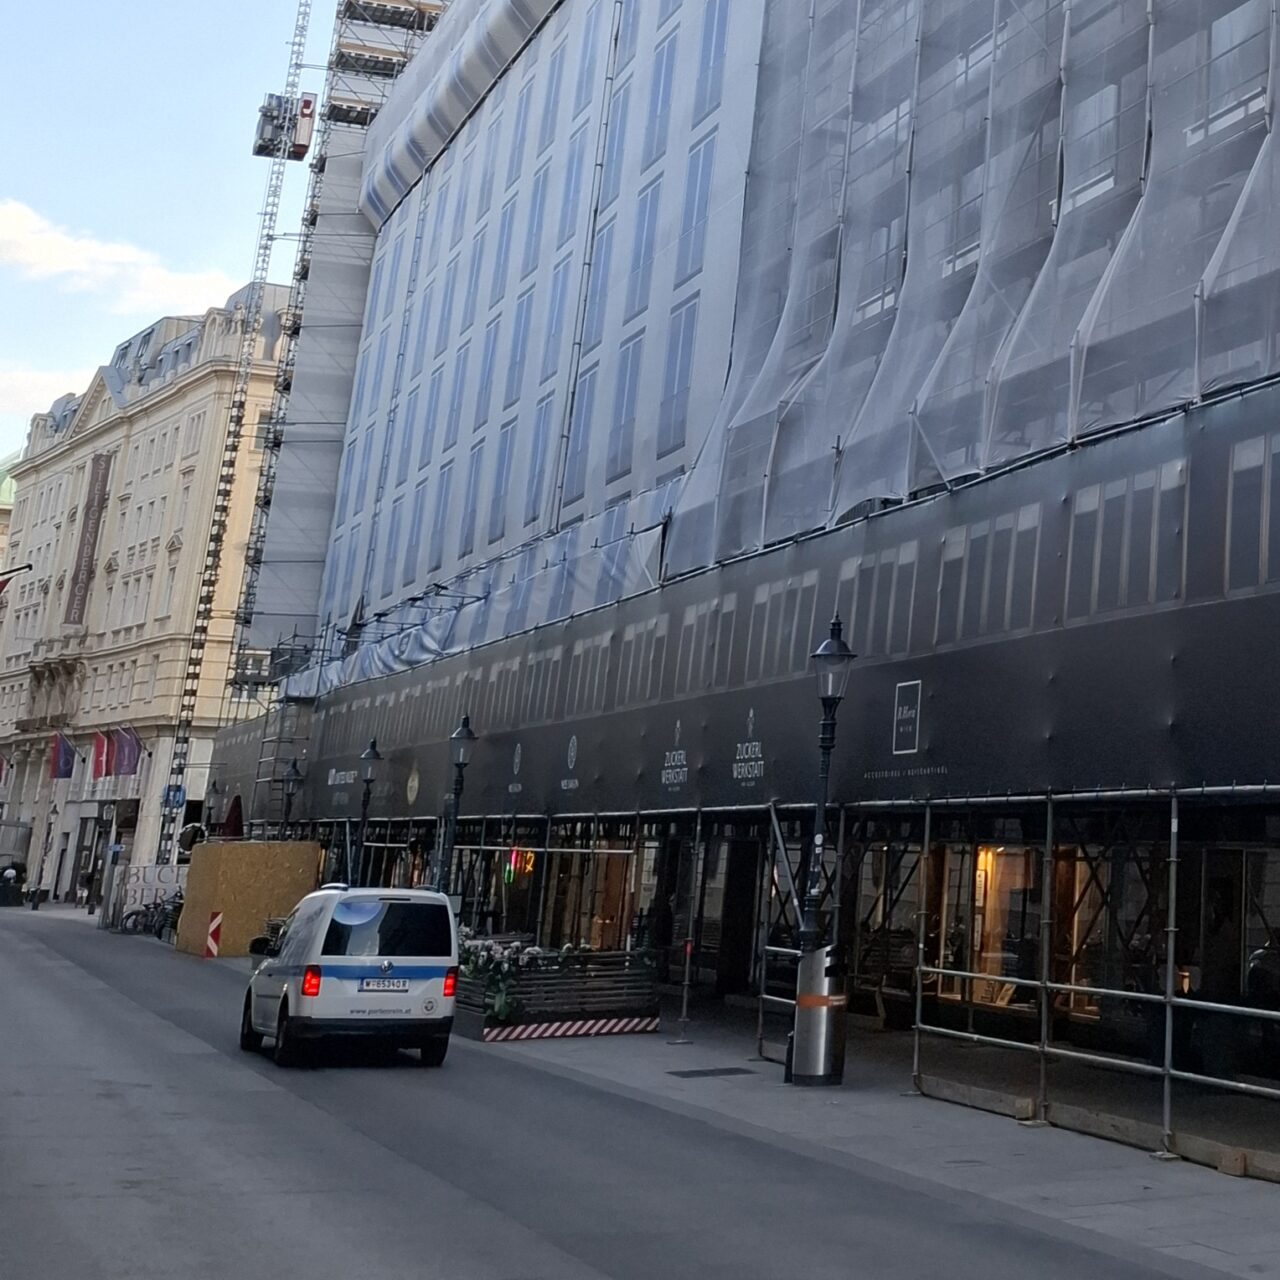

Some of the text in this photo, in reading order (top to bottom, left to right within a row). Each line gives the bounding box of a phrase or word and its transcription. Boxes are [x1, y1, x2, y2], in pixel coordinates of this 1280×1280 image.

[664, 750, 687, 767] ZUCKERL
[736, 741, 762, 760] ZUCKERL
[661, 767, 688, 784] WERKSTATT
[732, 760, 764, 779] WERKSTATT
